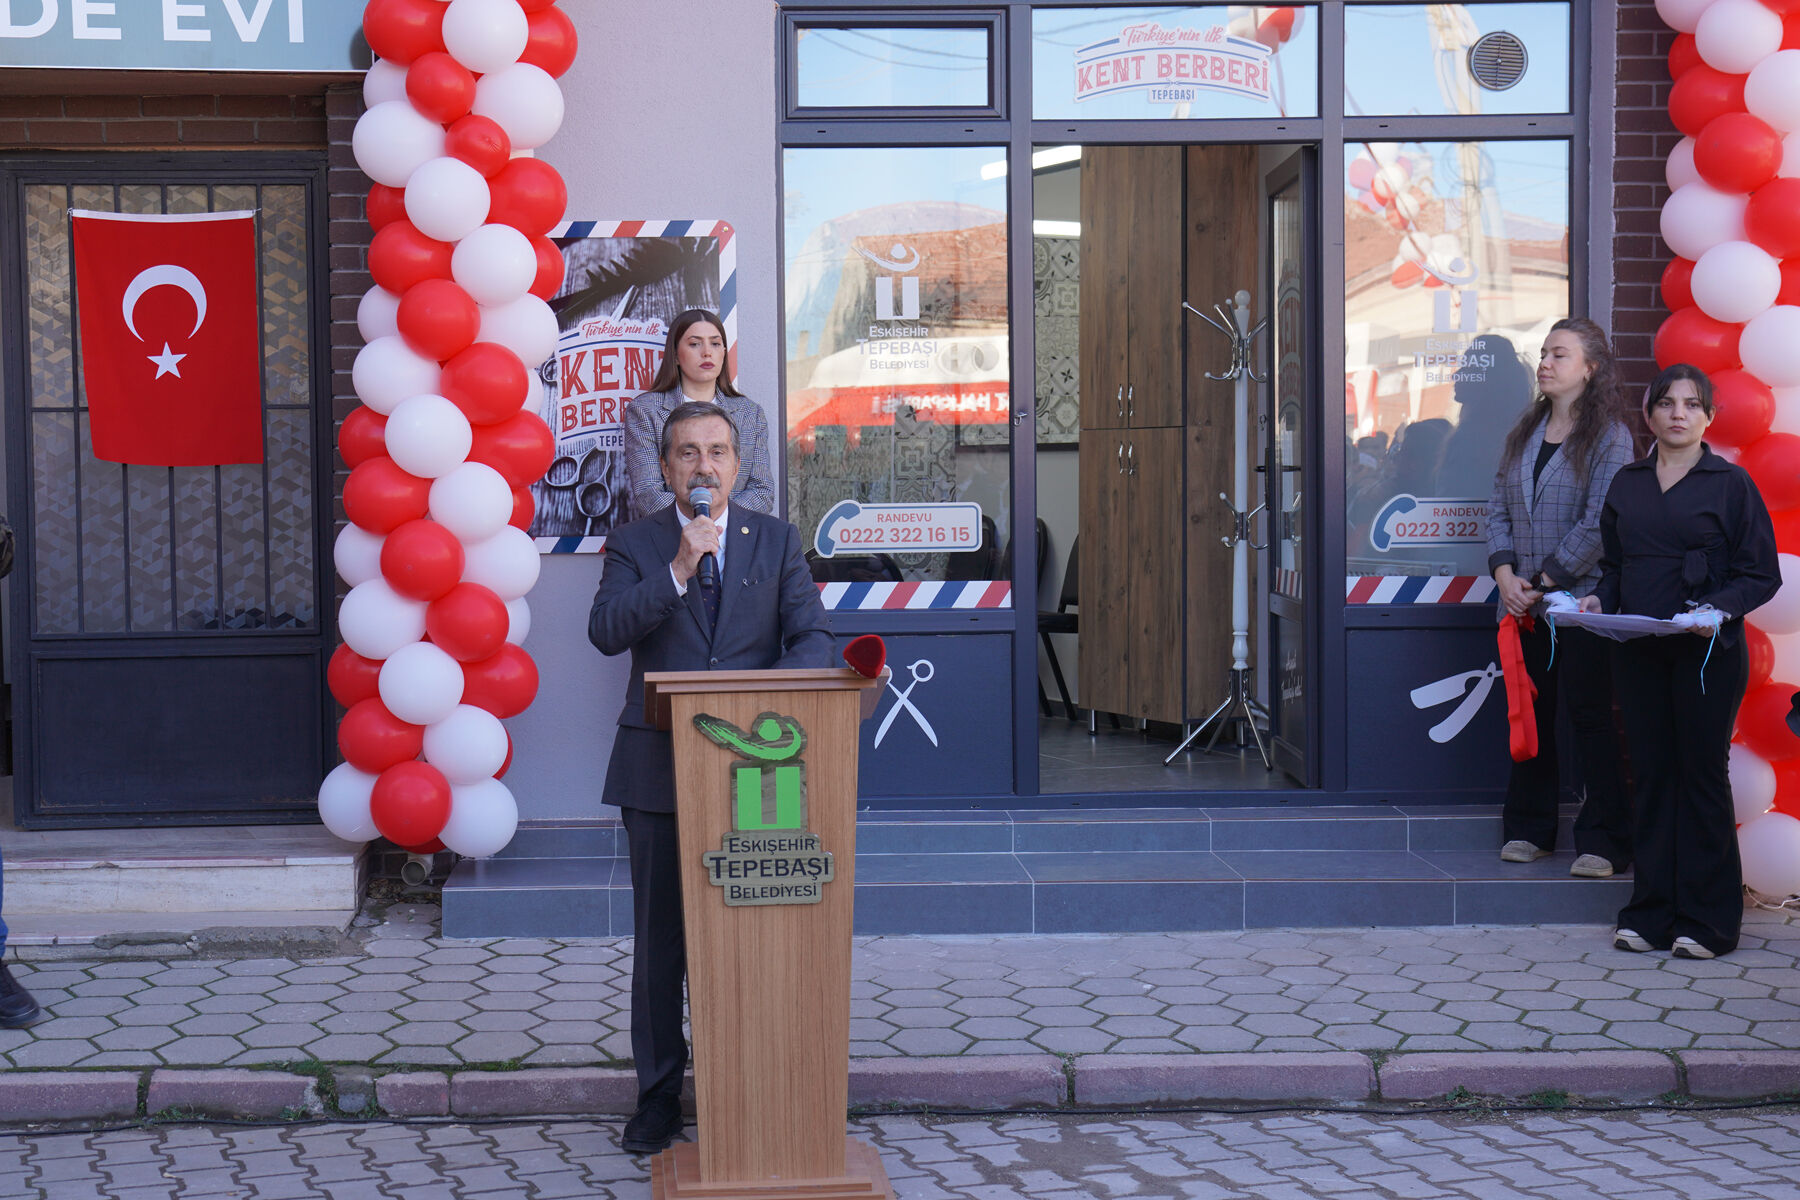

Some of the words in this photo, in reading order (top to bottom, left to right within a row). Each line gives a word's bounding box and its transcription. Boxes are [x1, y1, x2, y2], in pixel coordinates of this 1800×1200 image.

[1204, 25, 1224, 43] ilk
[1078, 55, 1146, 92] KENT
[1157, 53, 1269, 92] BERBERİ
[646, 322, 660, 336] ilk
[1412, 351, 1495, 371] TEPEBAŞI
[600, 435, 623, 447] TEPE
[877, 513, 932, 523] RANDEVU
[1433, 507, 1488, 517] RANDEVU
[839, 528, 885, 543] 0222
[890, 527, 922, 543] 322
[927, 527, 946, 542] 16
[951, 526, 970, 542] 15
[1395, 522, 1440, 537] 0222
[1445, 521, 1478, 537] 322
[709, 857, 829, 881] TEPEBAŞI
[730, 883, 817, 899] BELEDİYESİ
